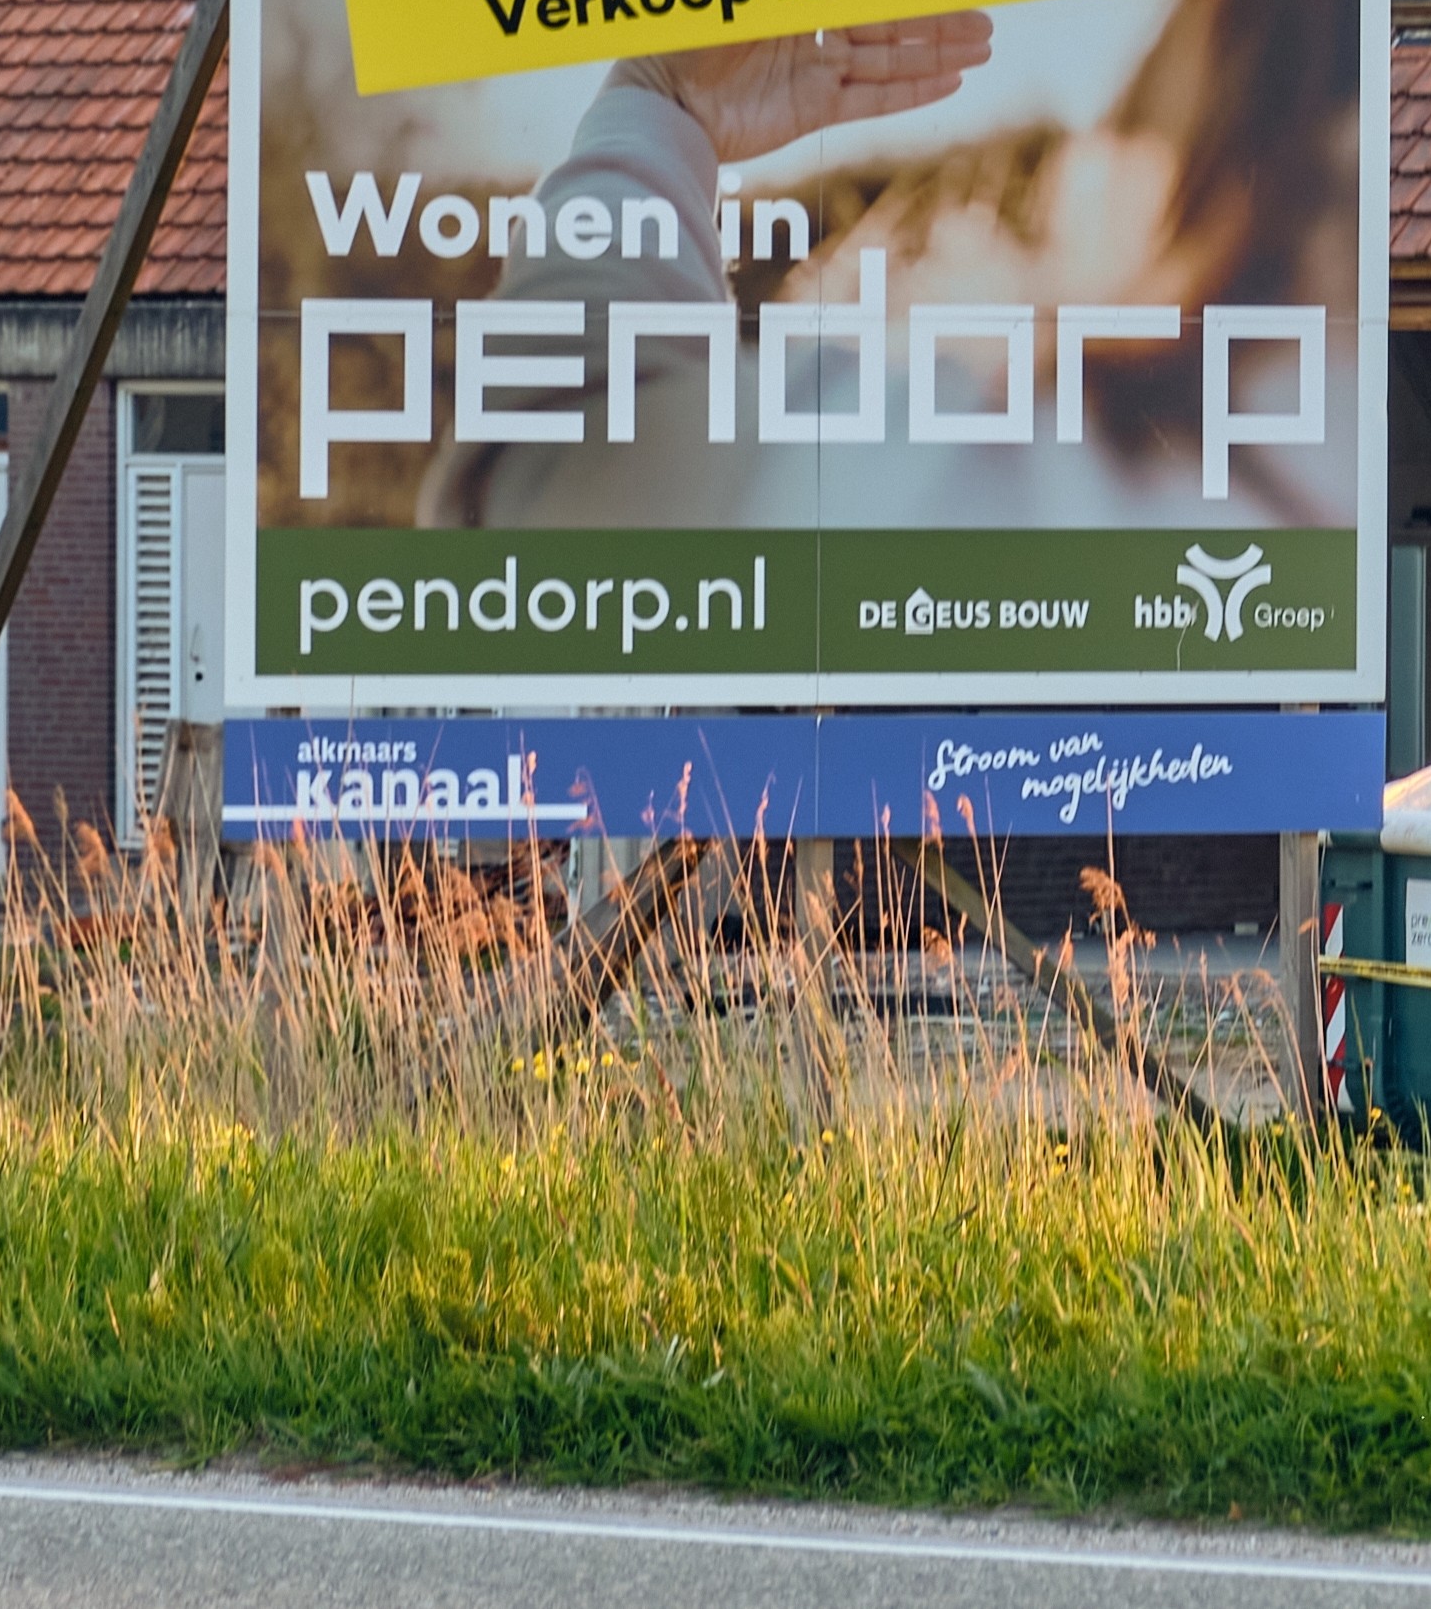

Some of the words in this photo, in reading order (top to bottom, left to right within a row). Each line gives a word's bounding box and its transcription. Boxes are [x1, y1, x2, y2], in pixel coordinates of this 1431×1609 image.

[304, 171, 679, 259] Wonen
[719, 171, 809, 261] in
[299, 248, 1326, 499] pendorp
[299, 555, 766, 653] pendorp.nl
[859, 600, 897, 629] DE
[905, 594, 991, 633] GEUS
[999, 598, 1089, 629] BOUW
[1134, 594, 1192, 629] hbb
[297, 736, 417, 764] alkmaars
[928, 738, 1040, 791] Stroom
[1049, 732, 1103, 763] van
[1021, 742, 1233, 824] mogelijkheden
